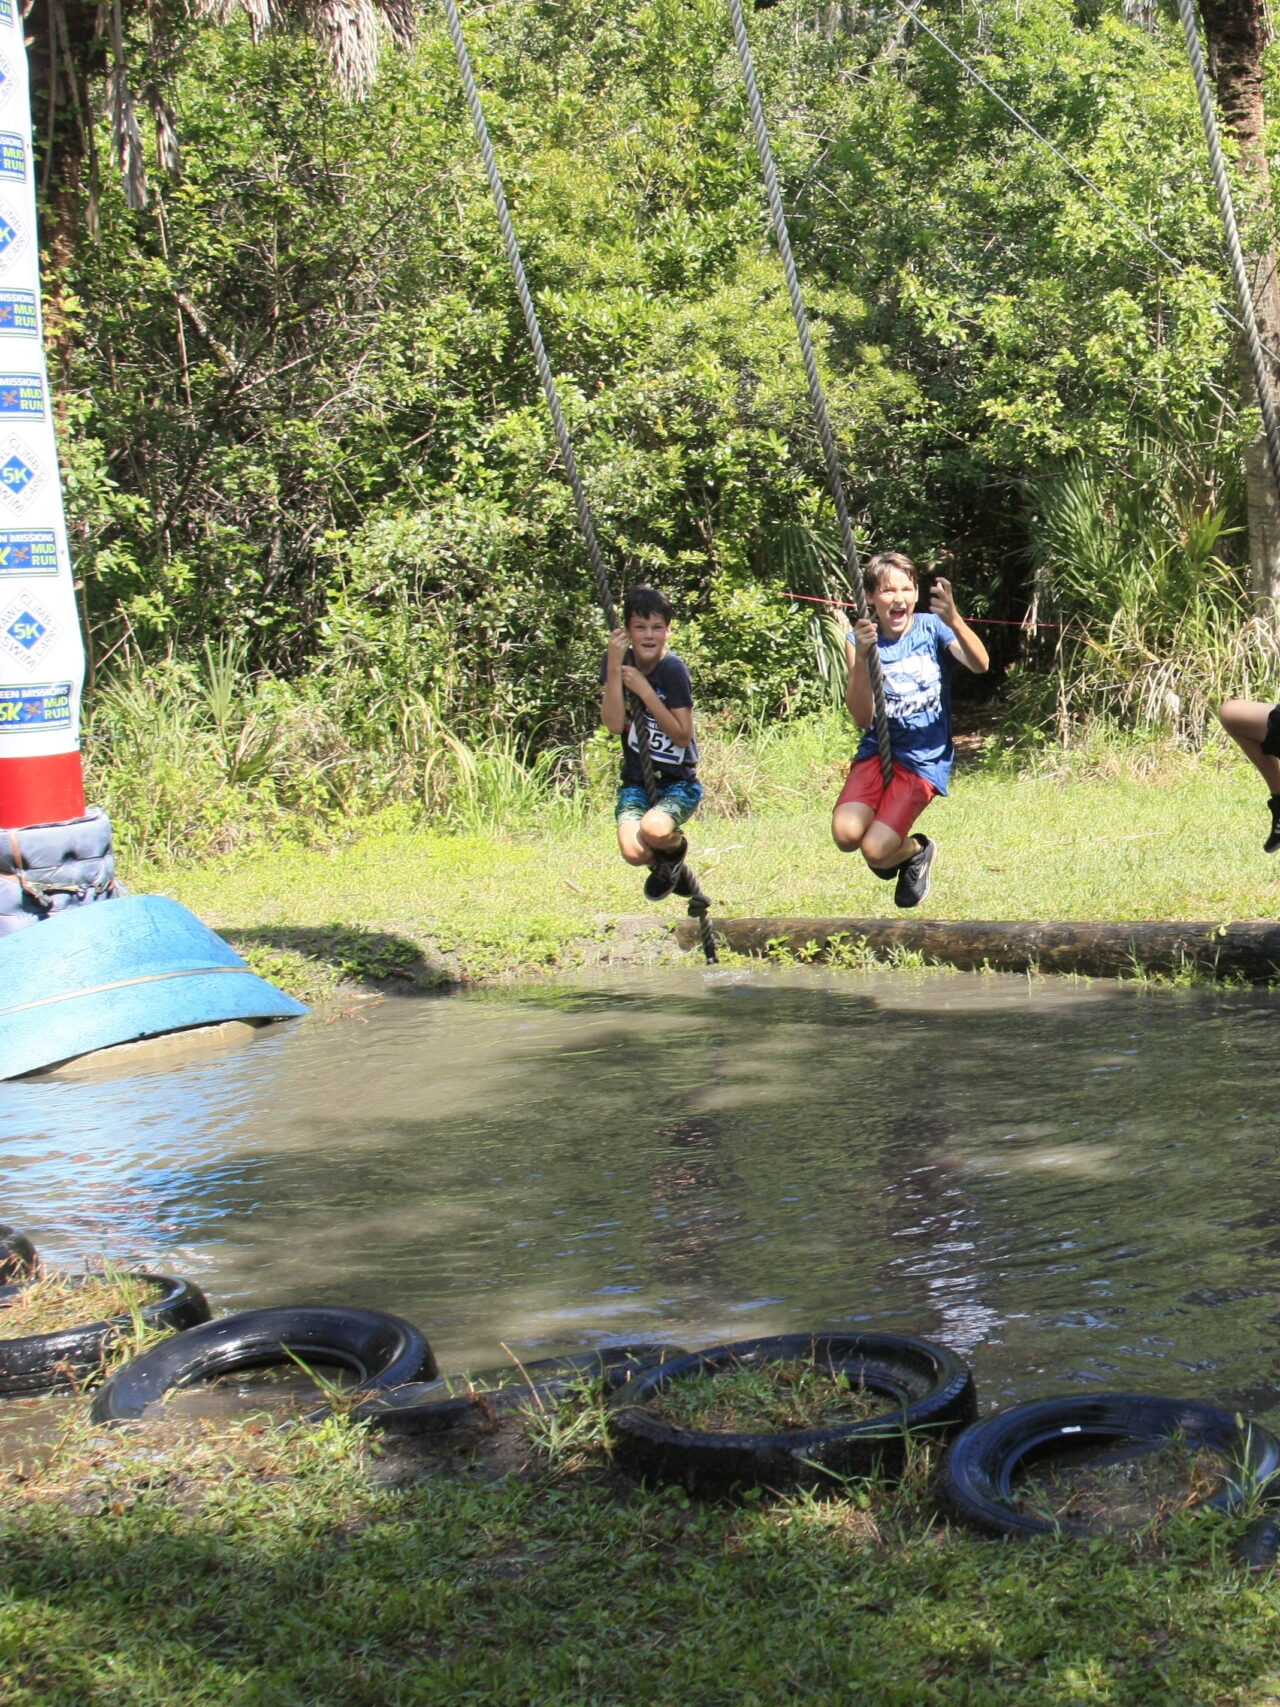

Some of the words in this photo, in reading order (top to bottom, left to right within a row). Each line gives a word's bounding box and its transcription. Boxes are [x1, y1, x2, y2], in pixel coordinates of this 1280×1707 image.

[14, 304, 36, 315] MUD
[15, 316, 37, 327] RUN
[20, 388, 42, 399] MUD
[21, 400, 44, 411] RUN
[3, 468, 28, 483] 5K
[31, 543, 56, 554] MUD
[32, 555, 57, 566] RUN
[14, 623, 40, 640] 5K
[43, 696, 68, 708] MUD
[44, 707, 70, 720] RUN
